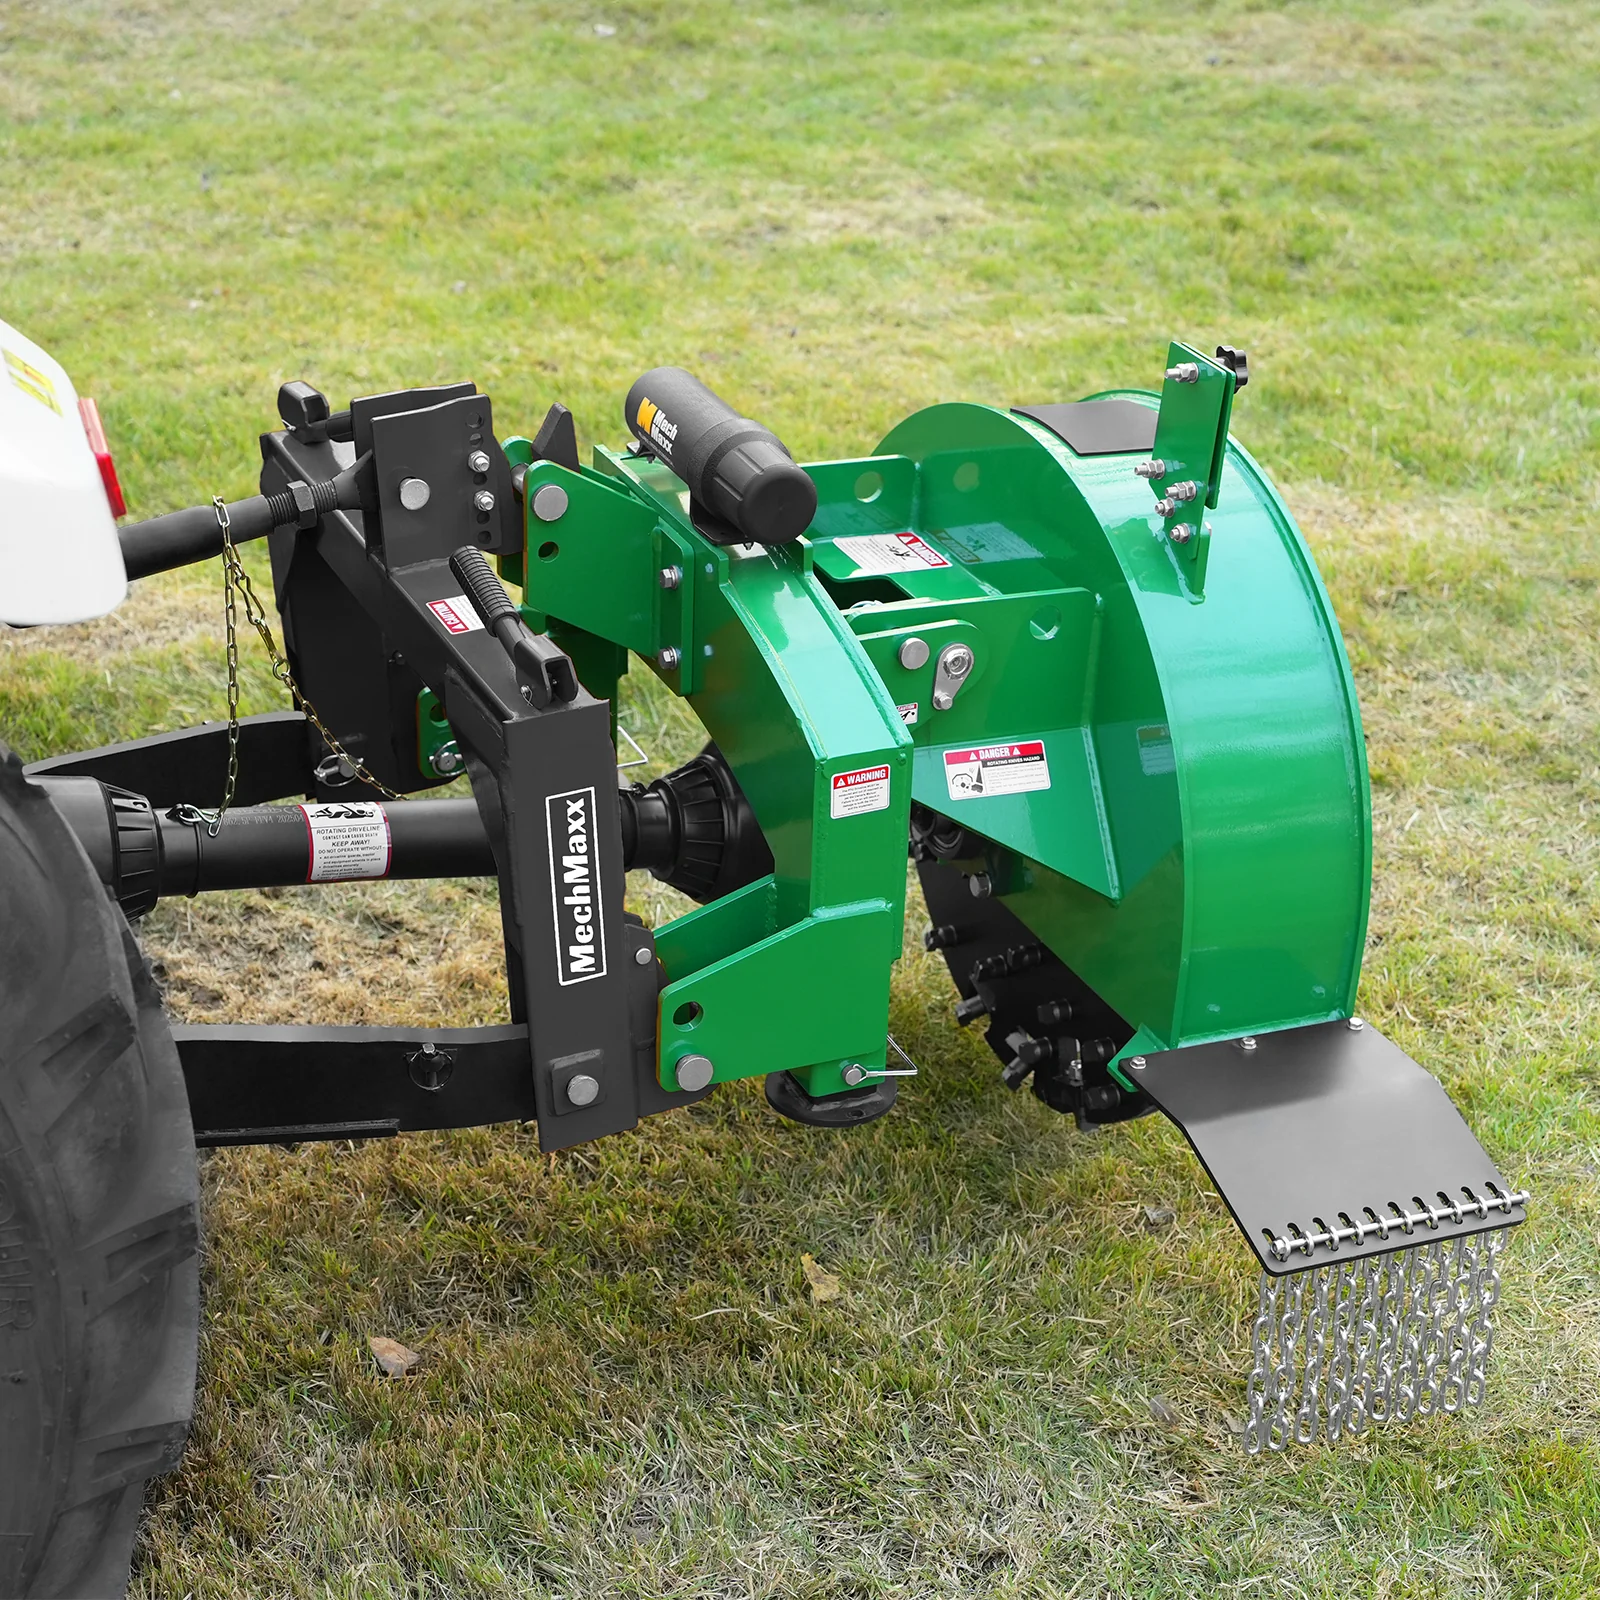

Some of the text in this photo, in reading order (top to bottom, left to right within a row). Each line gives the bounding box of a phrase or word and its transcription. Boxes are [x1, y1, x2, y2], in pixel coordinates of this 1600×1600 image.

[652, 409, 678, 441] Mech
[650, 423, 673, 455] Maxx
[978, 747, 1011, 760] DANGER
[1023, 755, 1040, 763] HAZARD
[846, 769, 886, 785] WARNING
[316, 827, 347, 835] ROTATING
[562, 797, 596, 973] MechMaxx
